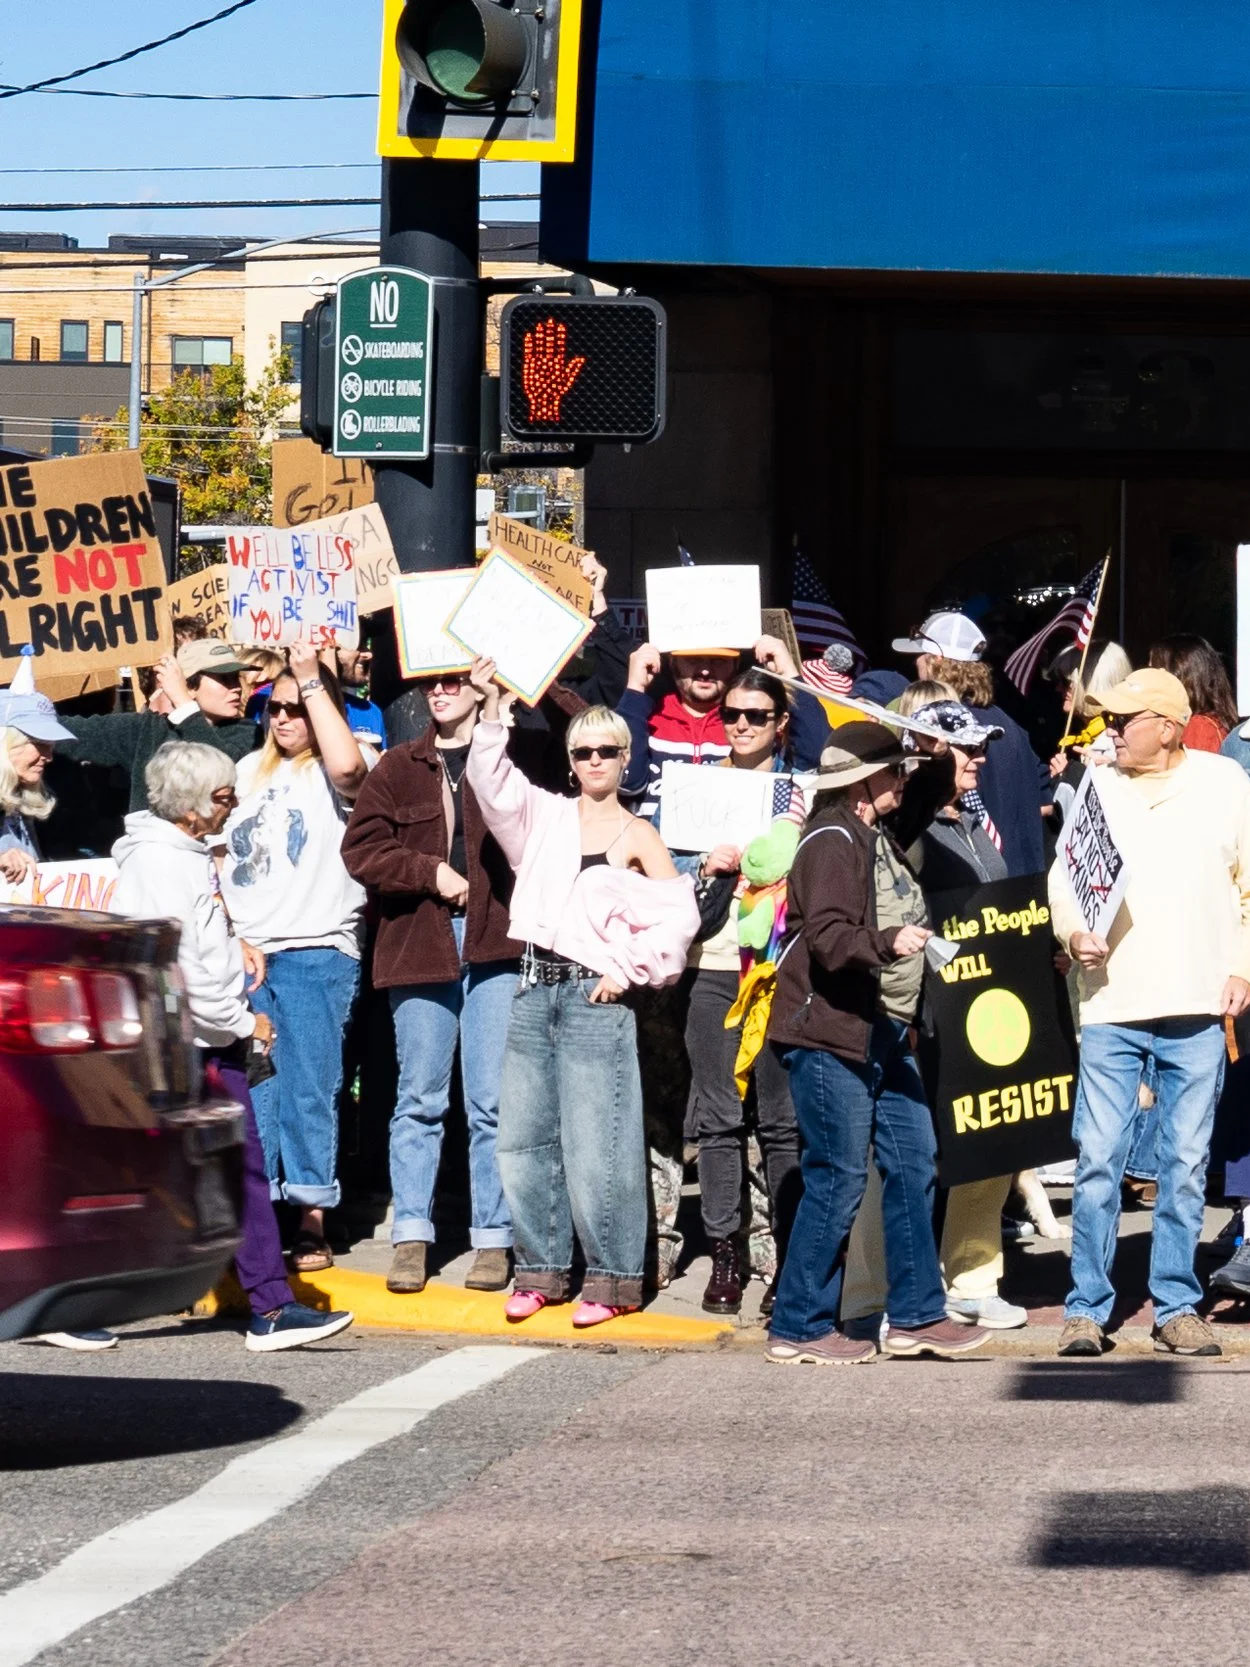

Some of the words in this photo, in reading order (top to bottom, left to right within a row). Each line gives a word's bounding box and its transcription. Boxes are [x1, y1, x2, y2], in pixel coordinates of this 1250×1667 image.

[370, 280, 400, 323] NO
[363, 341, 424, 359] SKATEBOARDING
[363, 379, 395, 397] BICYCLE
[396, 379, 422, 397] RIDING
[363, 415, 421, 433] ROLLERBLADING
[0, 490, 158, 556] ILDREN
[291, 534, 313, 571] BE
[317, 535, 354, 571] LESS
[495, 516, 588, 572] HEALTHCAR
[53, 543, 147, 595] NOT
[247, 569, 341, 597] ACTIVIST
[531, 558, 555, 572] NOT
[192, 575, 230, 608] SCIE
[283, 596, 304, 623] BE
[233, 593, 250, 618] IF
[250, 608, 282, 642] YOU
[327, 600, 357, 638] SHIT
[943, 915, 980, 942] the
[981, 900, 1050, 936] People
[938, 953, 993, 984] WILL
[951, 1074, 1073, 1134] RESIST
